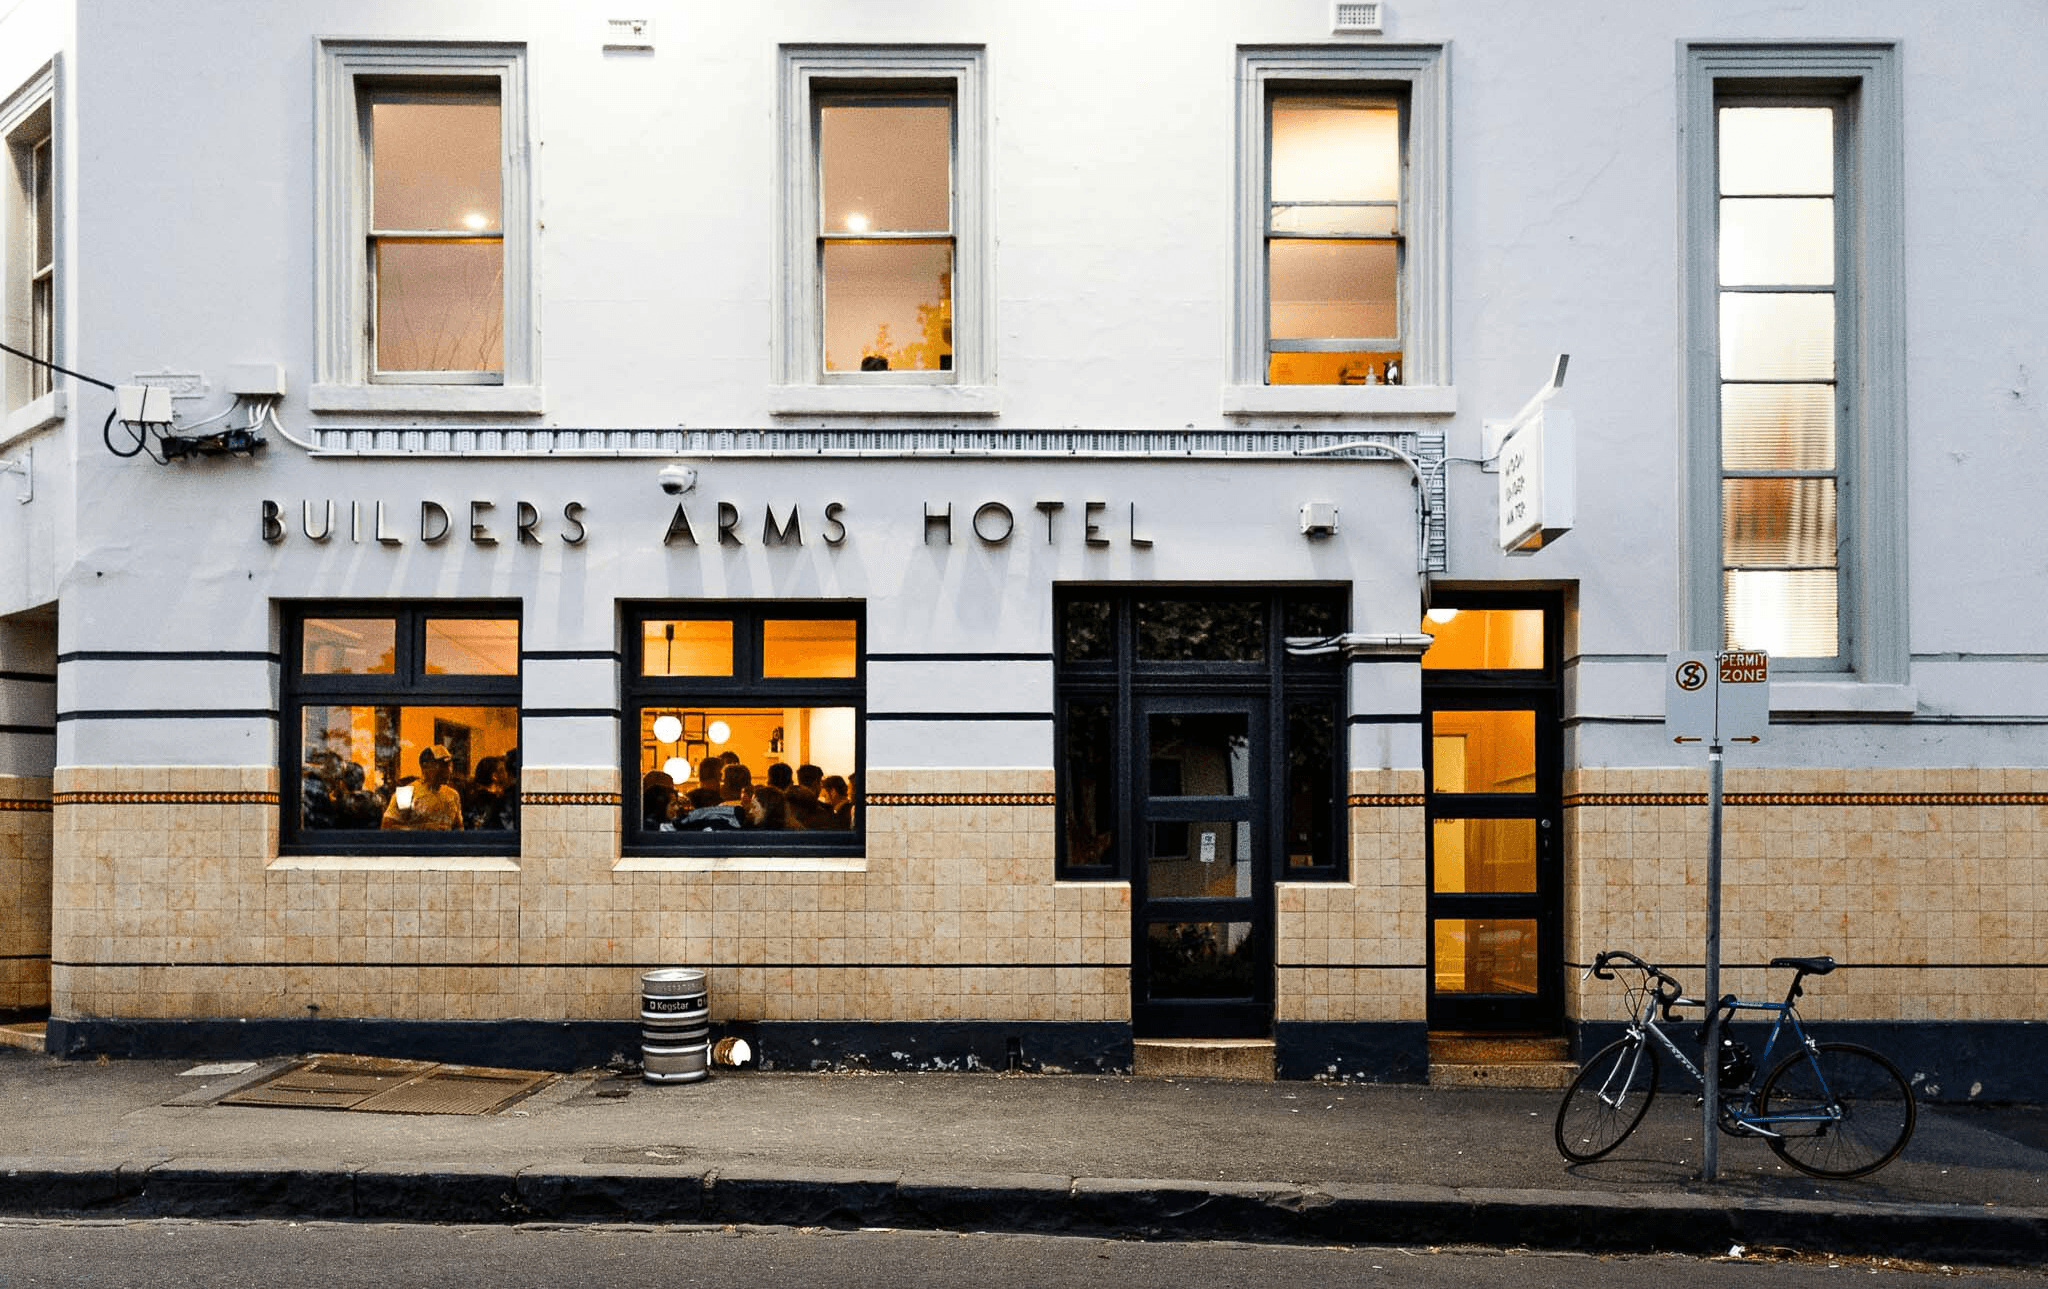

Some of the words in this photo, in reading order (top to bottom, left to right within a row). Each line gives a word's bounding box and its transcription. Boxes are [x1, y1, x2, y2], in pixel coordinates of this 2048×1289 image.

[262, 499, 588, 546] BUILDERS
[663, 501, 846, 547] ARMS
[923, 501, 1154, 547] HOTEL
[1721, 653, 1766, 667] PERMIT
[1721, 669, 1766, 682] ZONE
[657, 1001, 690, 1013] Kegstar
